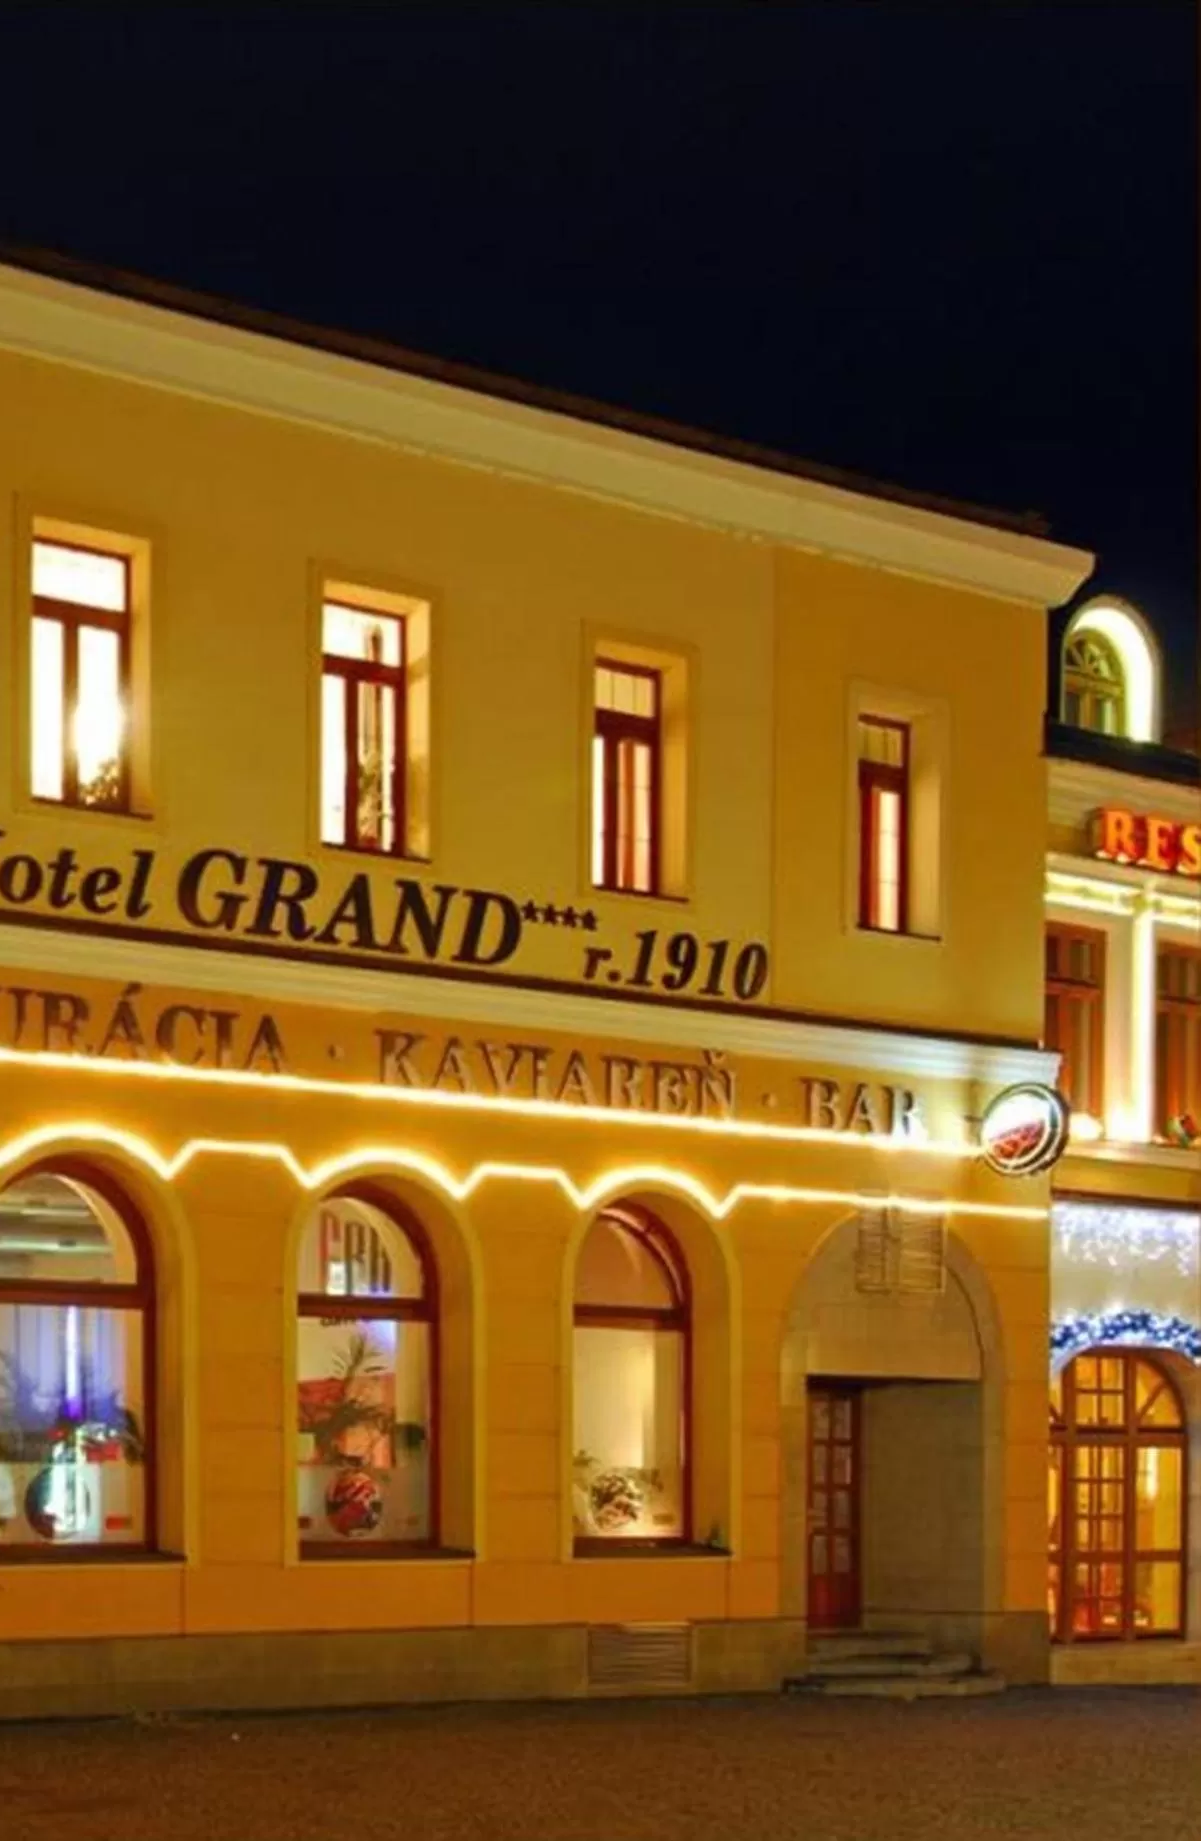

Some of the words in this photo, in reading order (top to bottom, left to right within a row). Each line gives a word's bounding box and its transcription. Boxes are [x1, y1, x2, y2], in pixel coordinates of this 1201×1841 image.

[177, 848, 522, 965] GRAND
[373, 1027, 735, 1122] KAVIAREŇ
[800, 1076, 925, 1142] BAR
